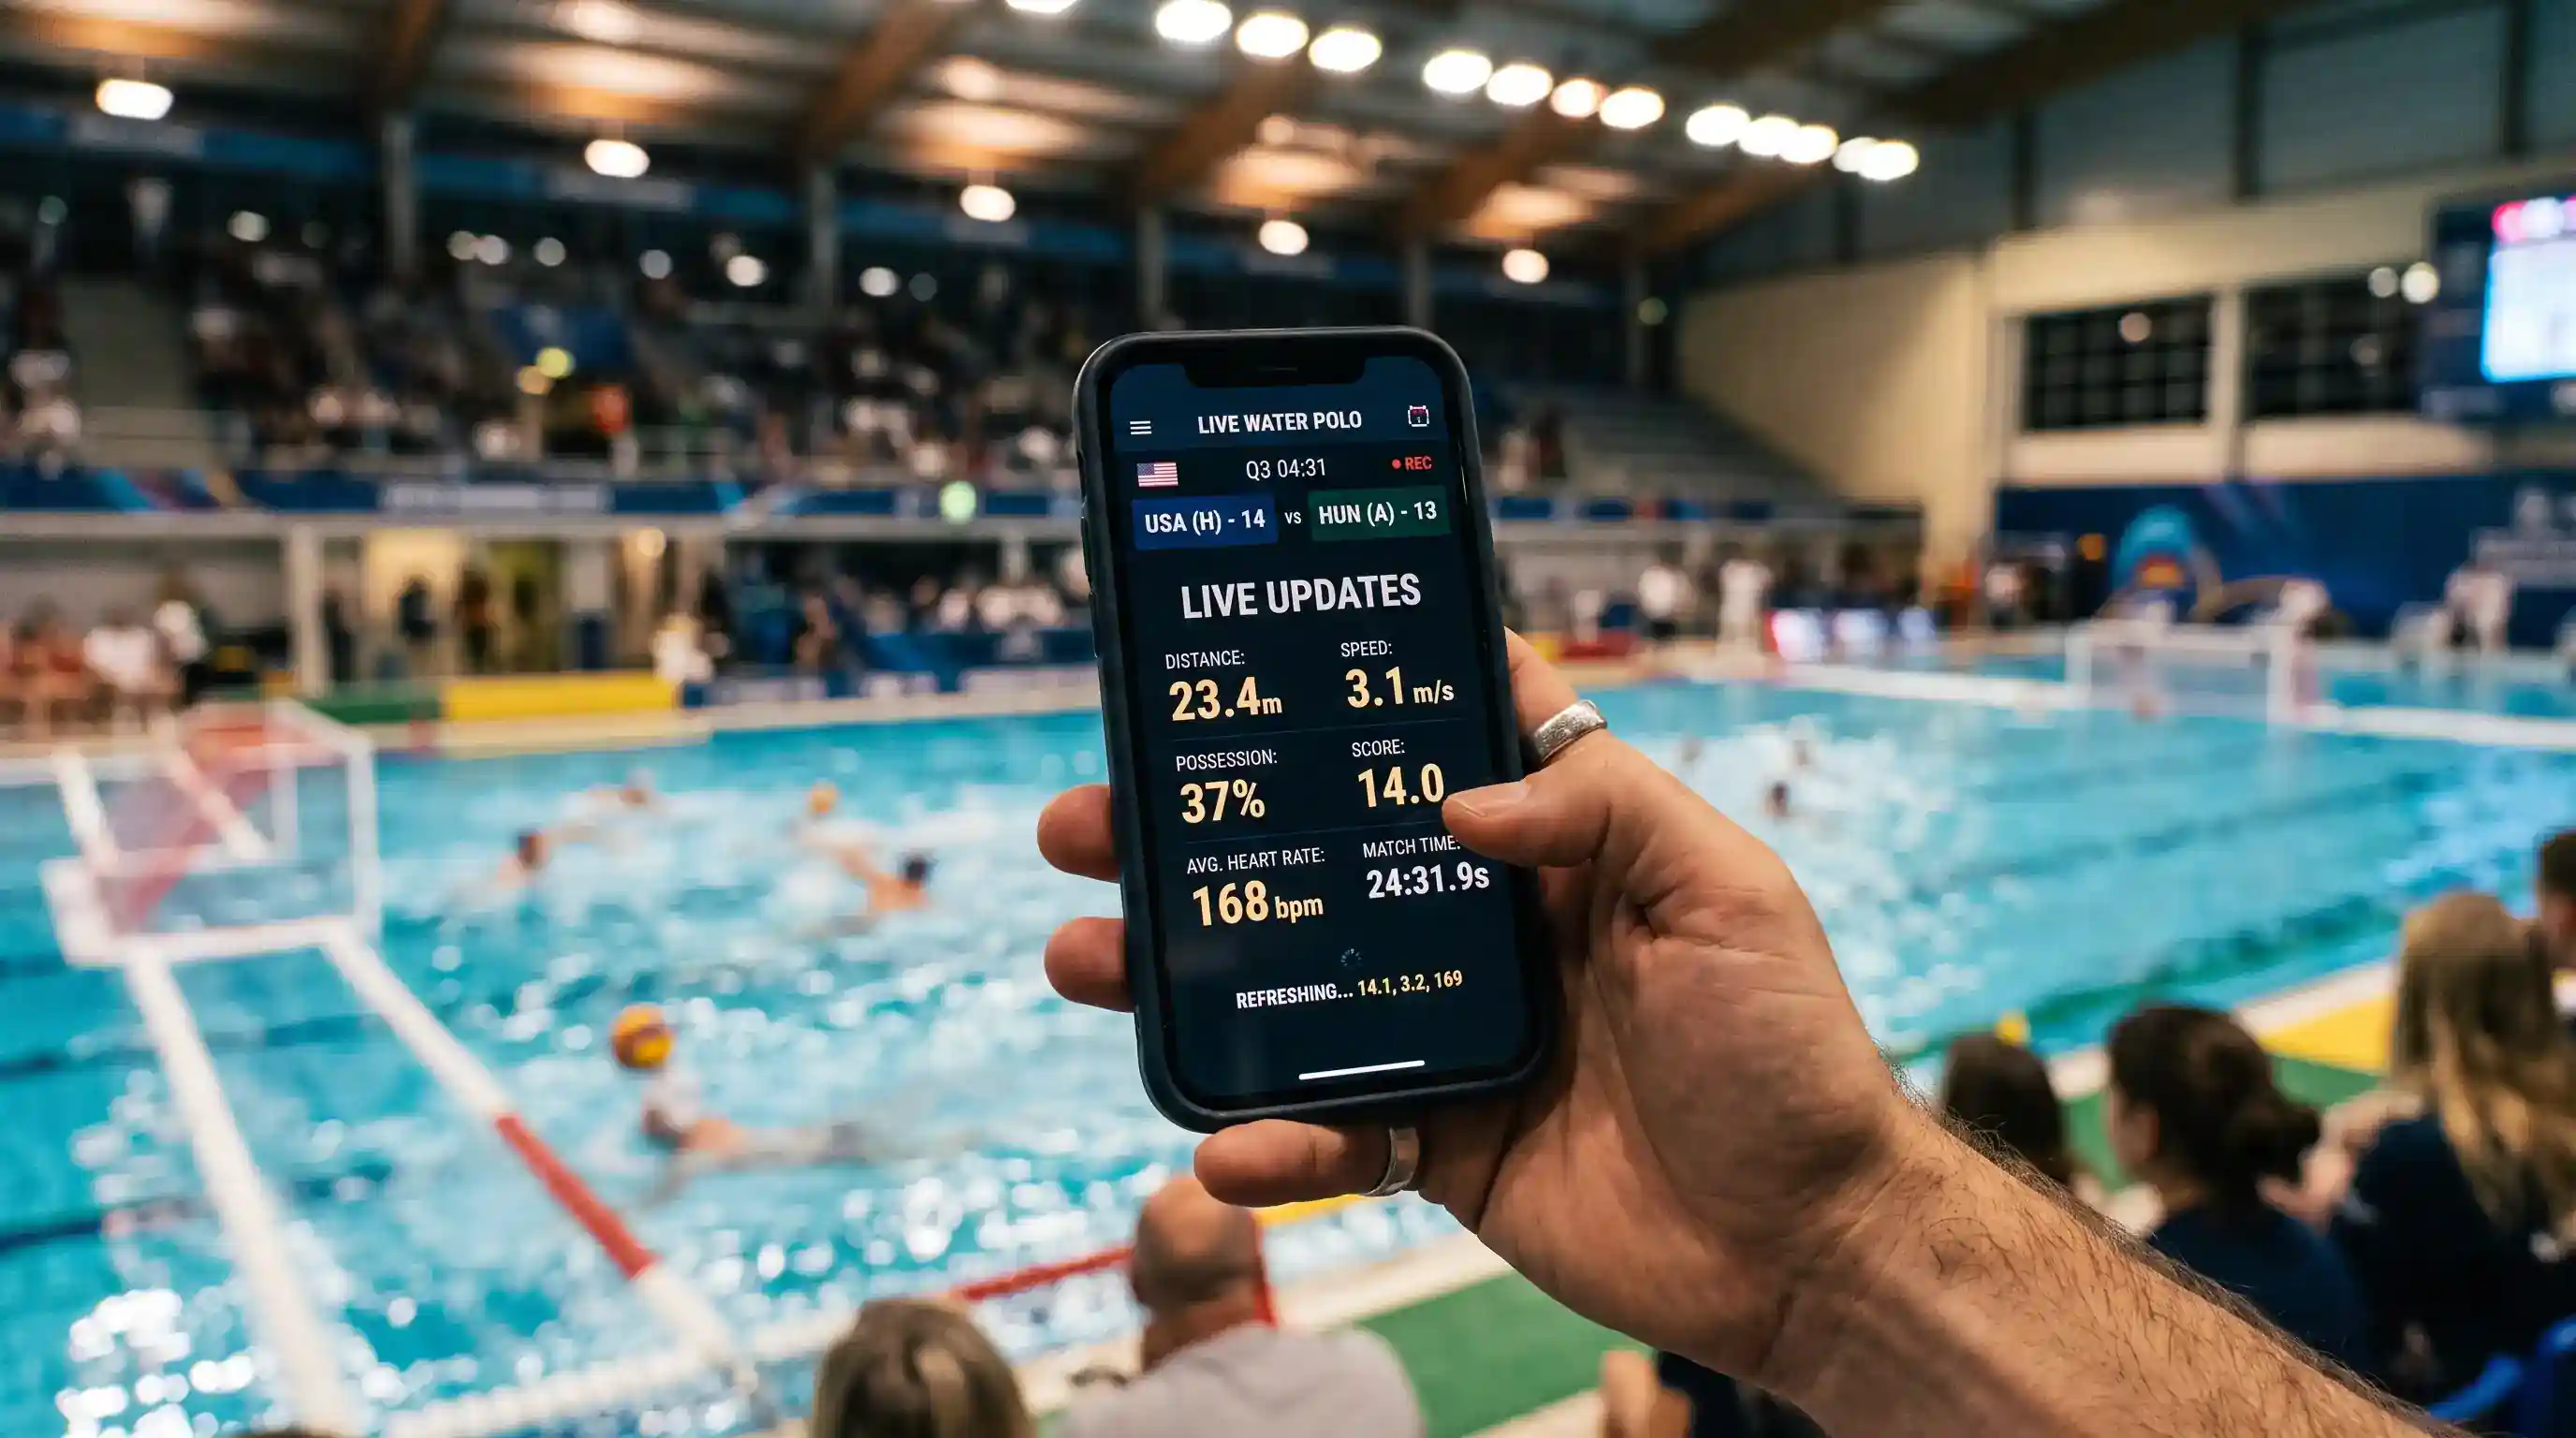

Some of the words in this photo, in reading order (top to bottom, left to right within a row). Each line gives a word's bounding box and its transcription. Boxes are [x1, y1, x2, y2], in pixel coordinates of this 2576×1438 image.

[1197, 414, 1240, 434] LIVE
[1242, 412, 1310, 433] WATER
[1312, 410, 1362, 430] POLO
[1247, 461, 1270, 482] Q3
[1277, 458, 1325, 478] 04:31
[1405, 455, 1432, 470] REC
[1144, 512, 1188, 534] USA
[1192, 508, 1222, 536] (H)
[1241, 508, 1266, 529] 14
[1318, 504, 1362, 525] HUN
[1367, 501, 1395, 527] (A)
[1413, 500, 1438, 521] 13
[1180, 581, 1258, 620] LIVE
[1266, 572, 1422, 614] UPDATES
[1164, 649, 1246, 670] DISTANCE:
[1340, 639, 1393, 658] SPEED:
[1345, 666, 1404, 709] 3.1
[1412, 679, 1455, 705] m/s
[1176, 748, 1278, 772] POSSESSION:
[1351, 739, 1406, 757] SCORE:
[1358, 764, 1444, 807] 14.0
[1179, 778, 1266, 824] 37%
[1186, 856, 1223, 874] AVG.
[1227, 850, 1278, 871] HEART
[1281, 846, 1325, 866] RATE:
[1362, 838, 1416, 858] MATCH
[1366, 860, 1490, 900] 24:31.9s
[1193, 880, 1269, 927] 168
[1274, 895, 1324, 924] bpm
[1236, 983, 1354, 1009] REFRESHING...
[1357, 976, 1398, 997] 14.1,
[1399, 974, 1430, 993] 3.2,
[1434, 969, 1463, 989] 169
